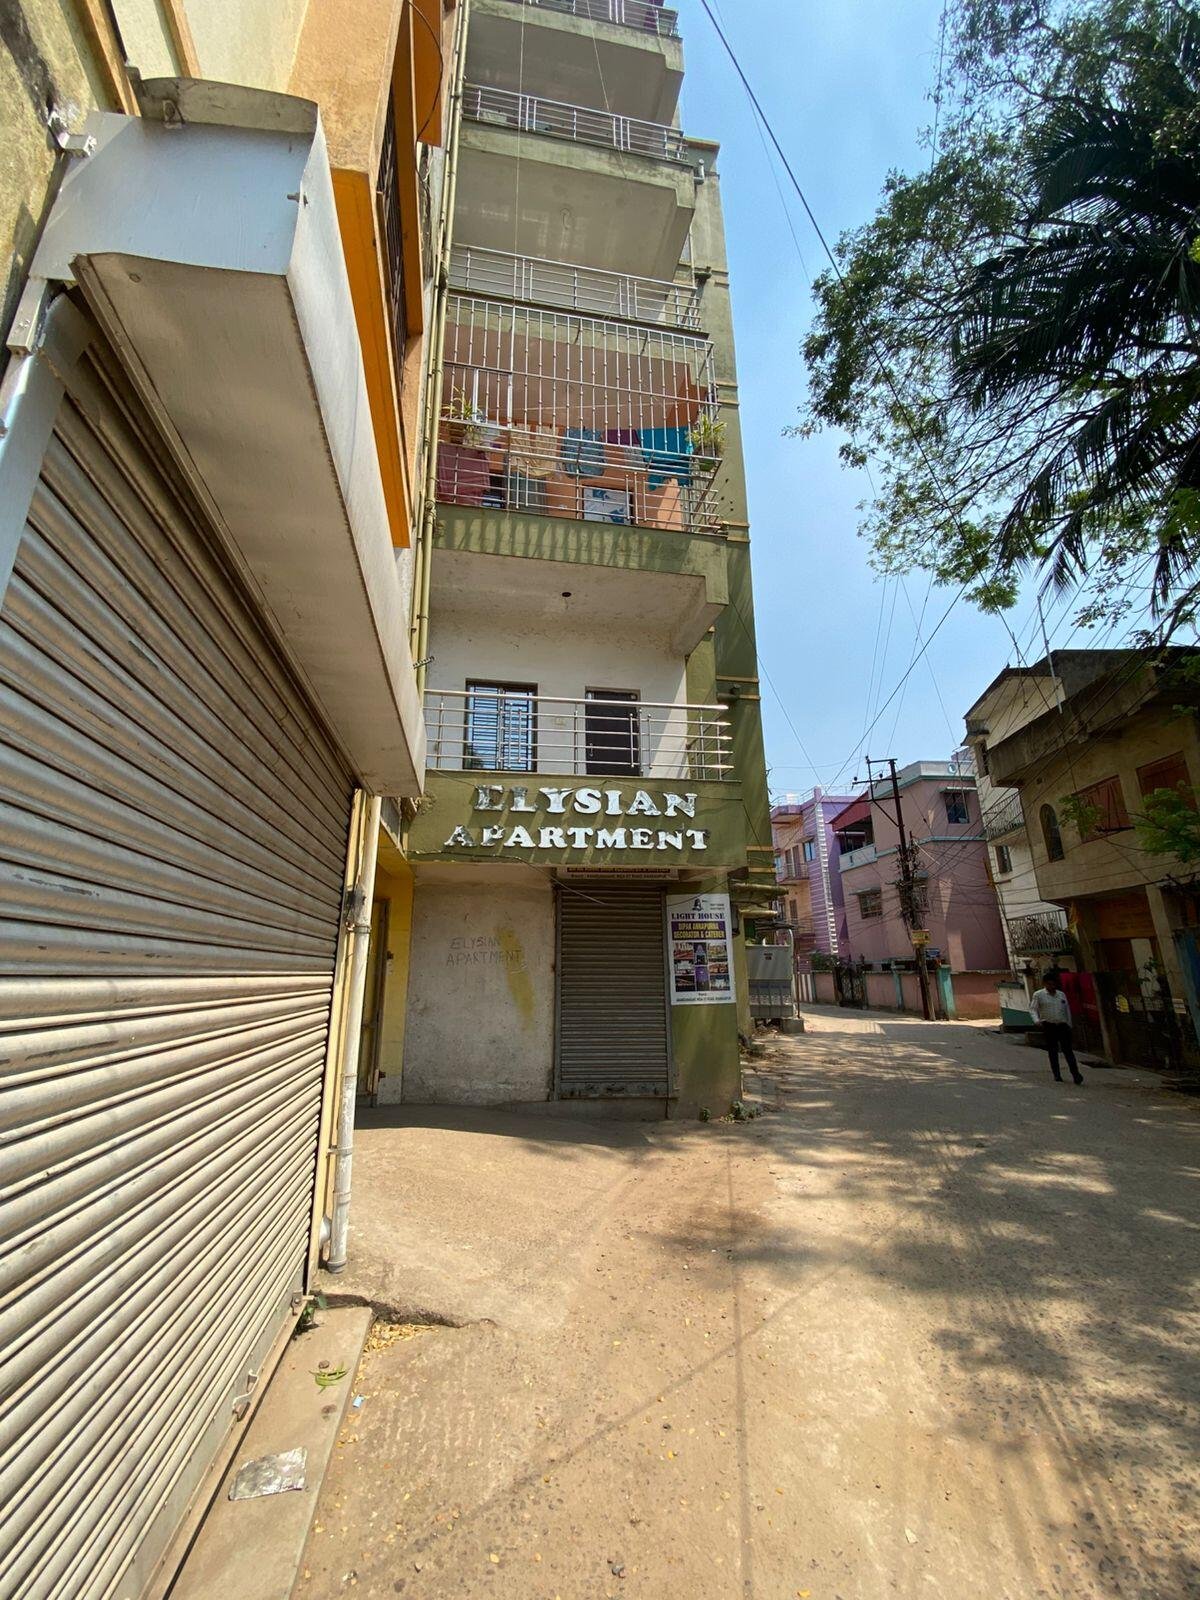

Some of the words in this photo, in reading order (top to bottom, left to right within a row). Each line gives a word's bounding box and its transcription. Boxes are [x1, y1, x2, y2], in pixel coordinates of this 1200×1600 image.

[474, 785, 698, 818] ELYSIAN
[443, 824, 710, 850] APARTMENT
[671, 912, 696, 920] LIGHT
[698, 912, 725, 920] HOUSE
